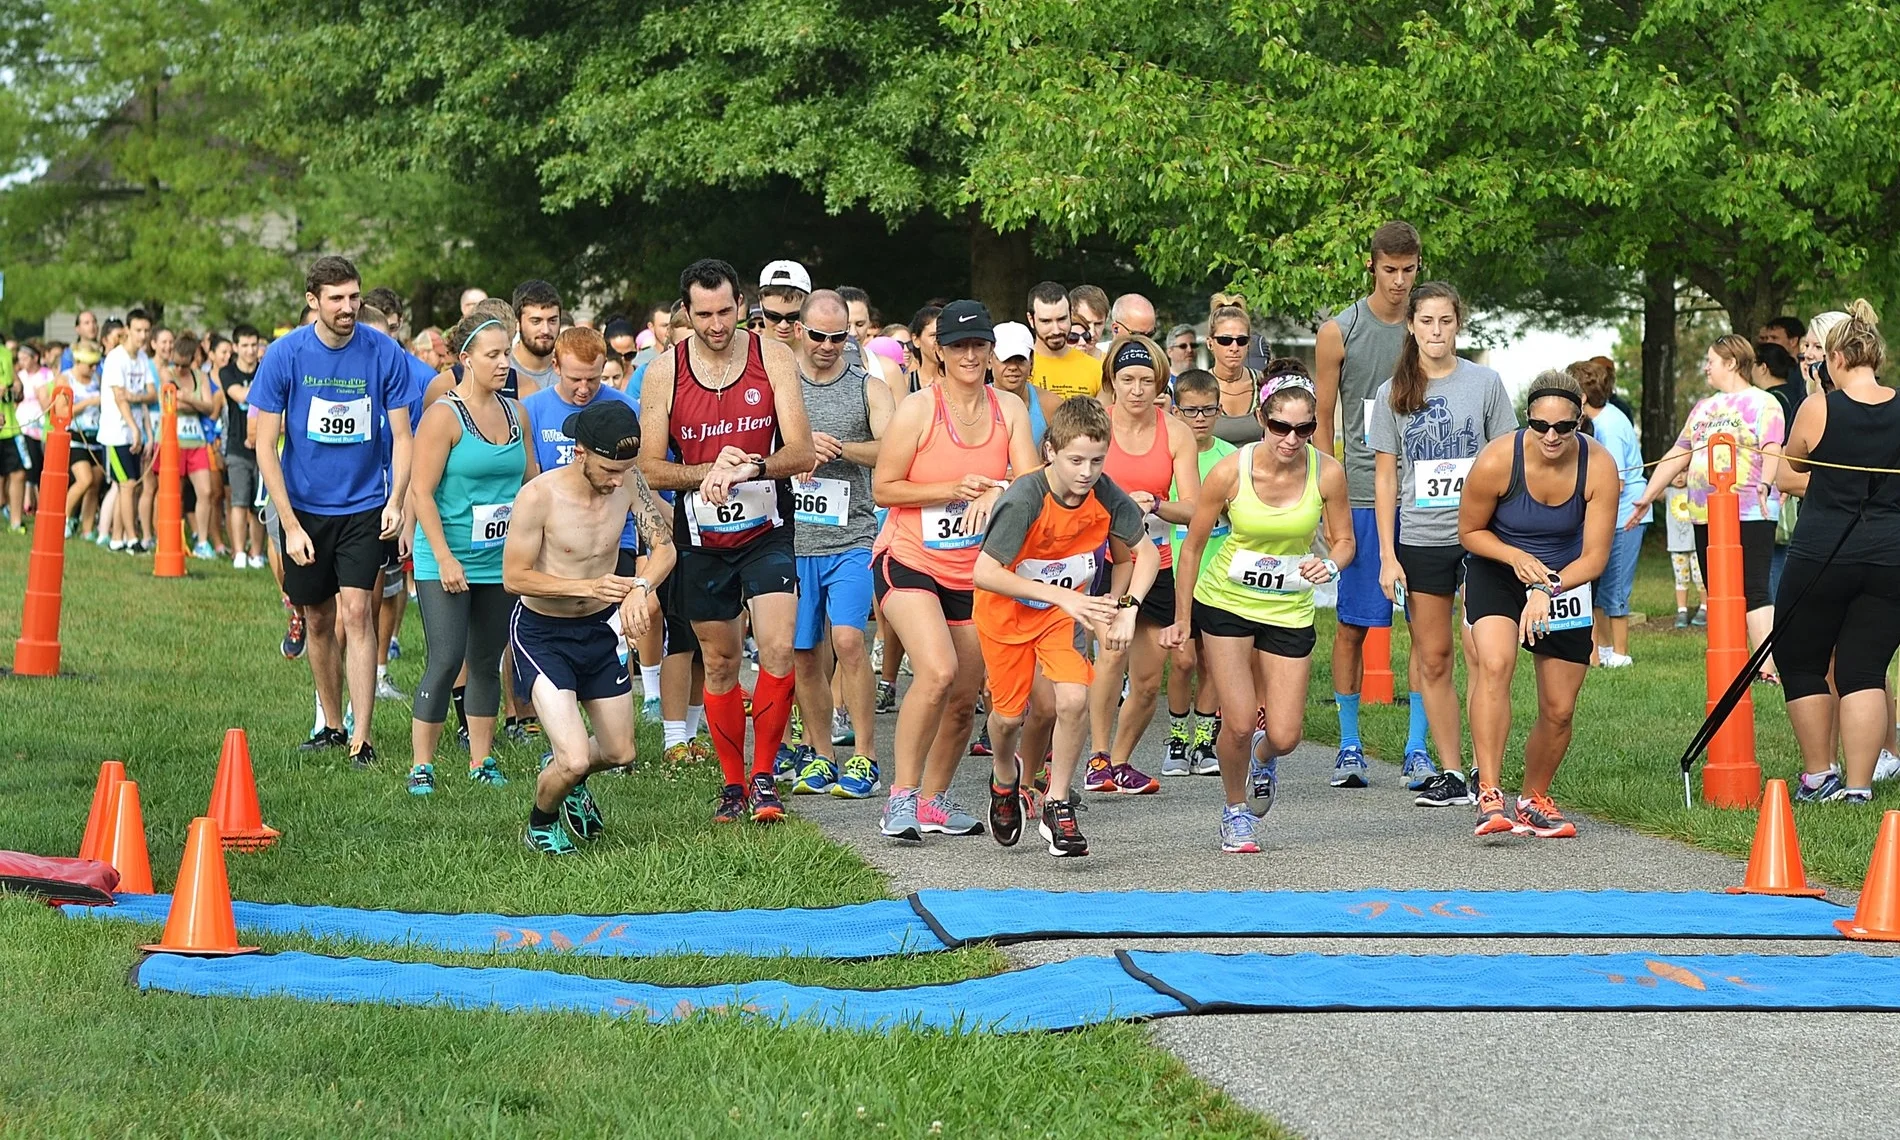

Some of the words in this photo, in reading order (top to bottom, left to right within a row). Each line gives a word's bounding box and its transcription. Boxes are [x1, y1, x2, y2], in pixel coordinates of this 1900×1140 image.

[182, 425, 198, 434] 441
[320, 417, 355, 434] 399
[681, 426, 697, 440] St.
[699, 420, 733, 442] Jude
[737, 415, 772, 432] Hero
[1406, 430, 1478, 466] KNIGHTS
[1427, 477, 1464, 497] 374
[716, 502, 746, 523] 62
[794, 493, 828, 513] 666
[740, 521, 754, 530] Run
[813, 514, 826, 522] Run
[938, 517, 975, 538] 34
[1242, 571, 1285, 589] 501
[1570, 620, 1583, 628] Run
